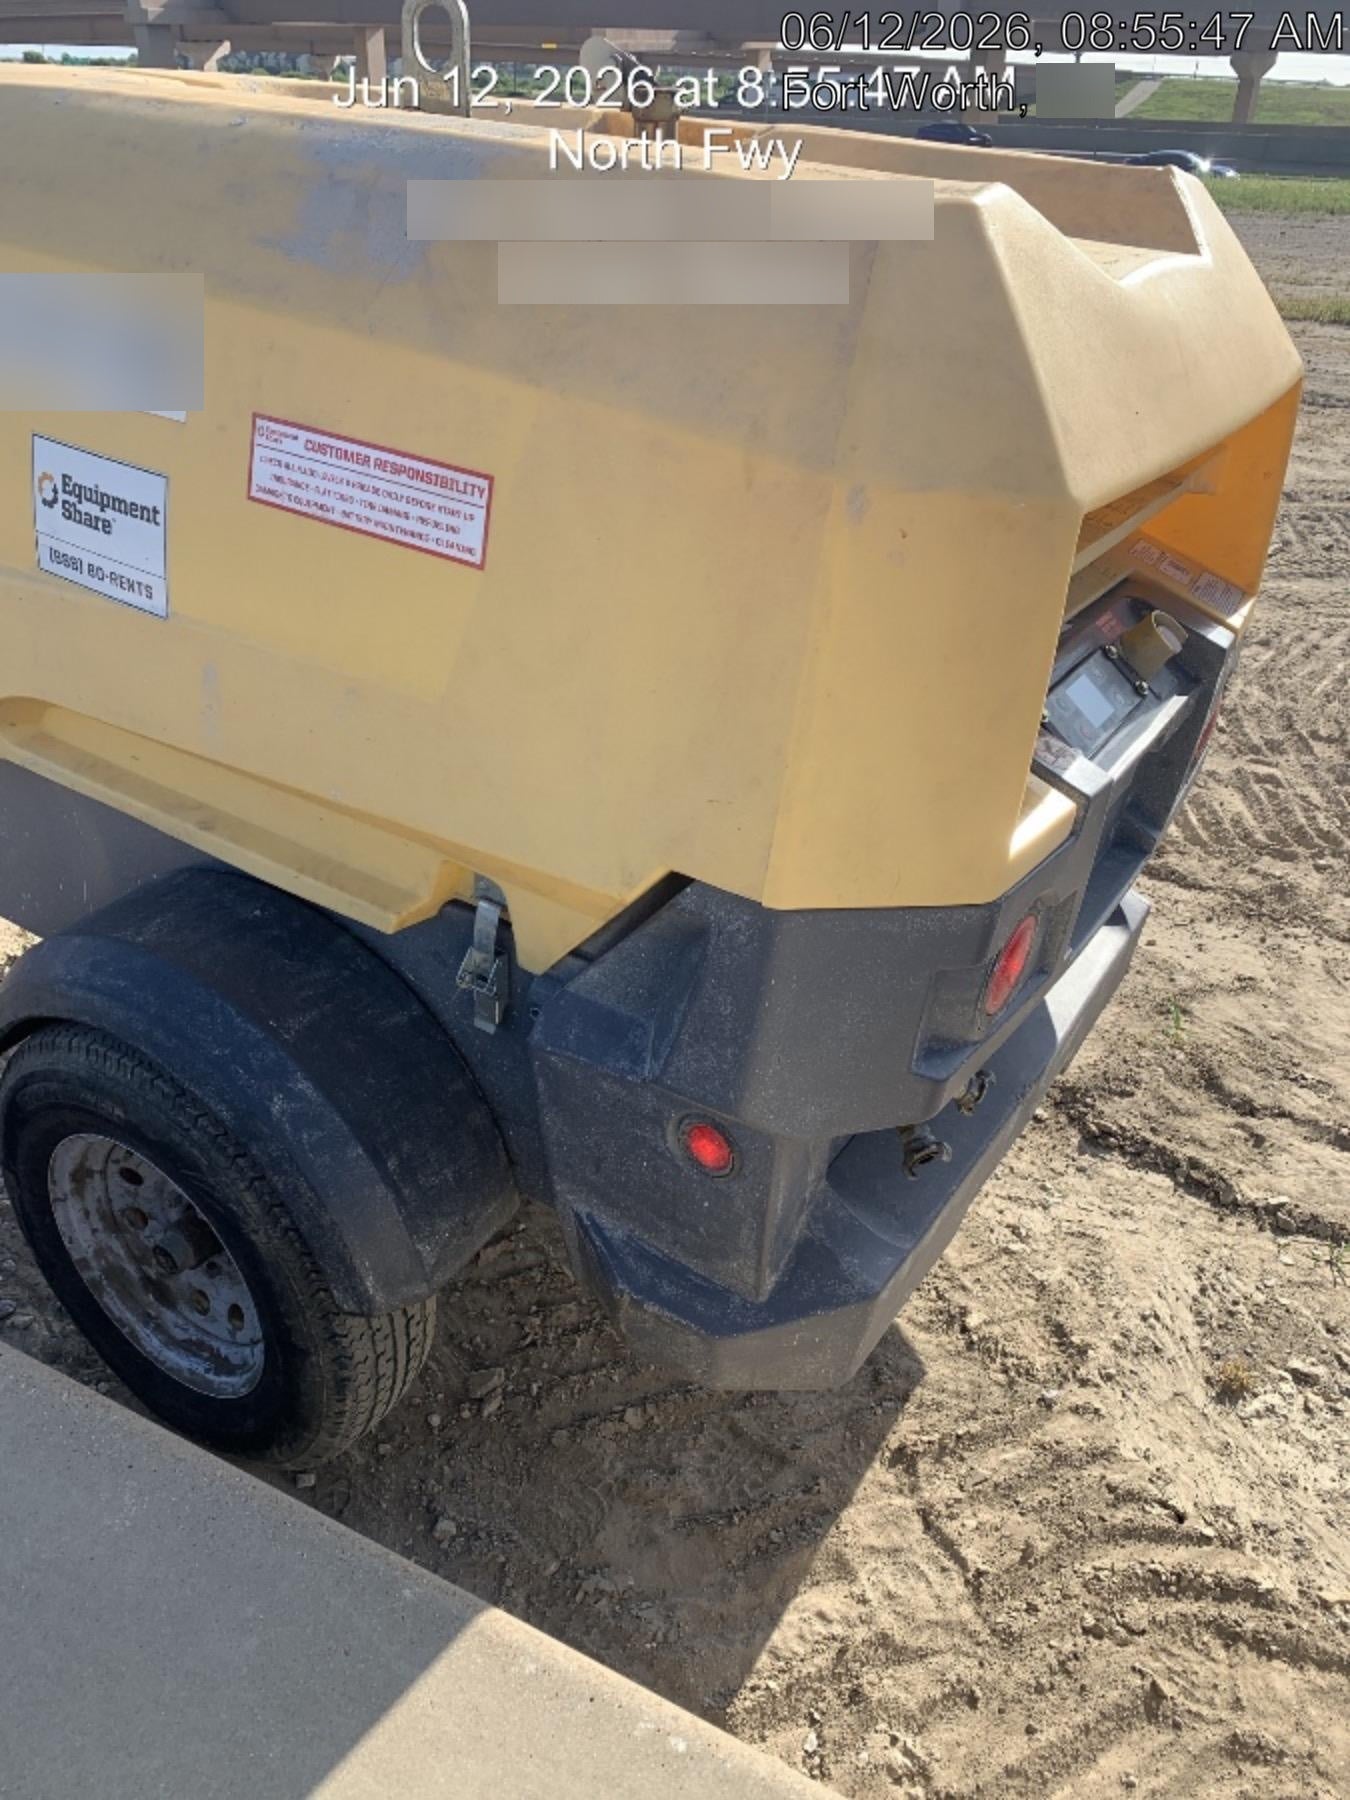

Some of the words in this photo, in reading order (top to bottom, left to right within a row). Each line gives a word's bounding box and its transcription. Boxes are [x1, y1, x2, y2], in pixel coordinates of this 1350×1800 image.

[304, 439, 371, 469] CUSTOMER
[373, 457, 486, 499] RESPONSIBILITY
[61, 473, 161, 527] Equipment
[61, 499, 113, 535] Share
